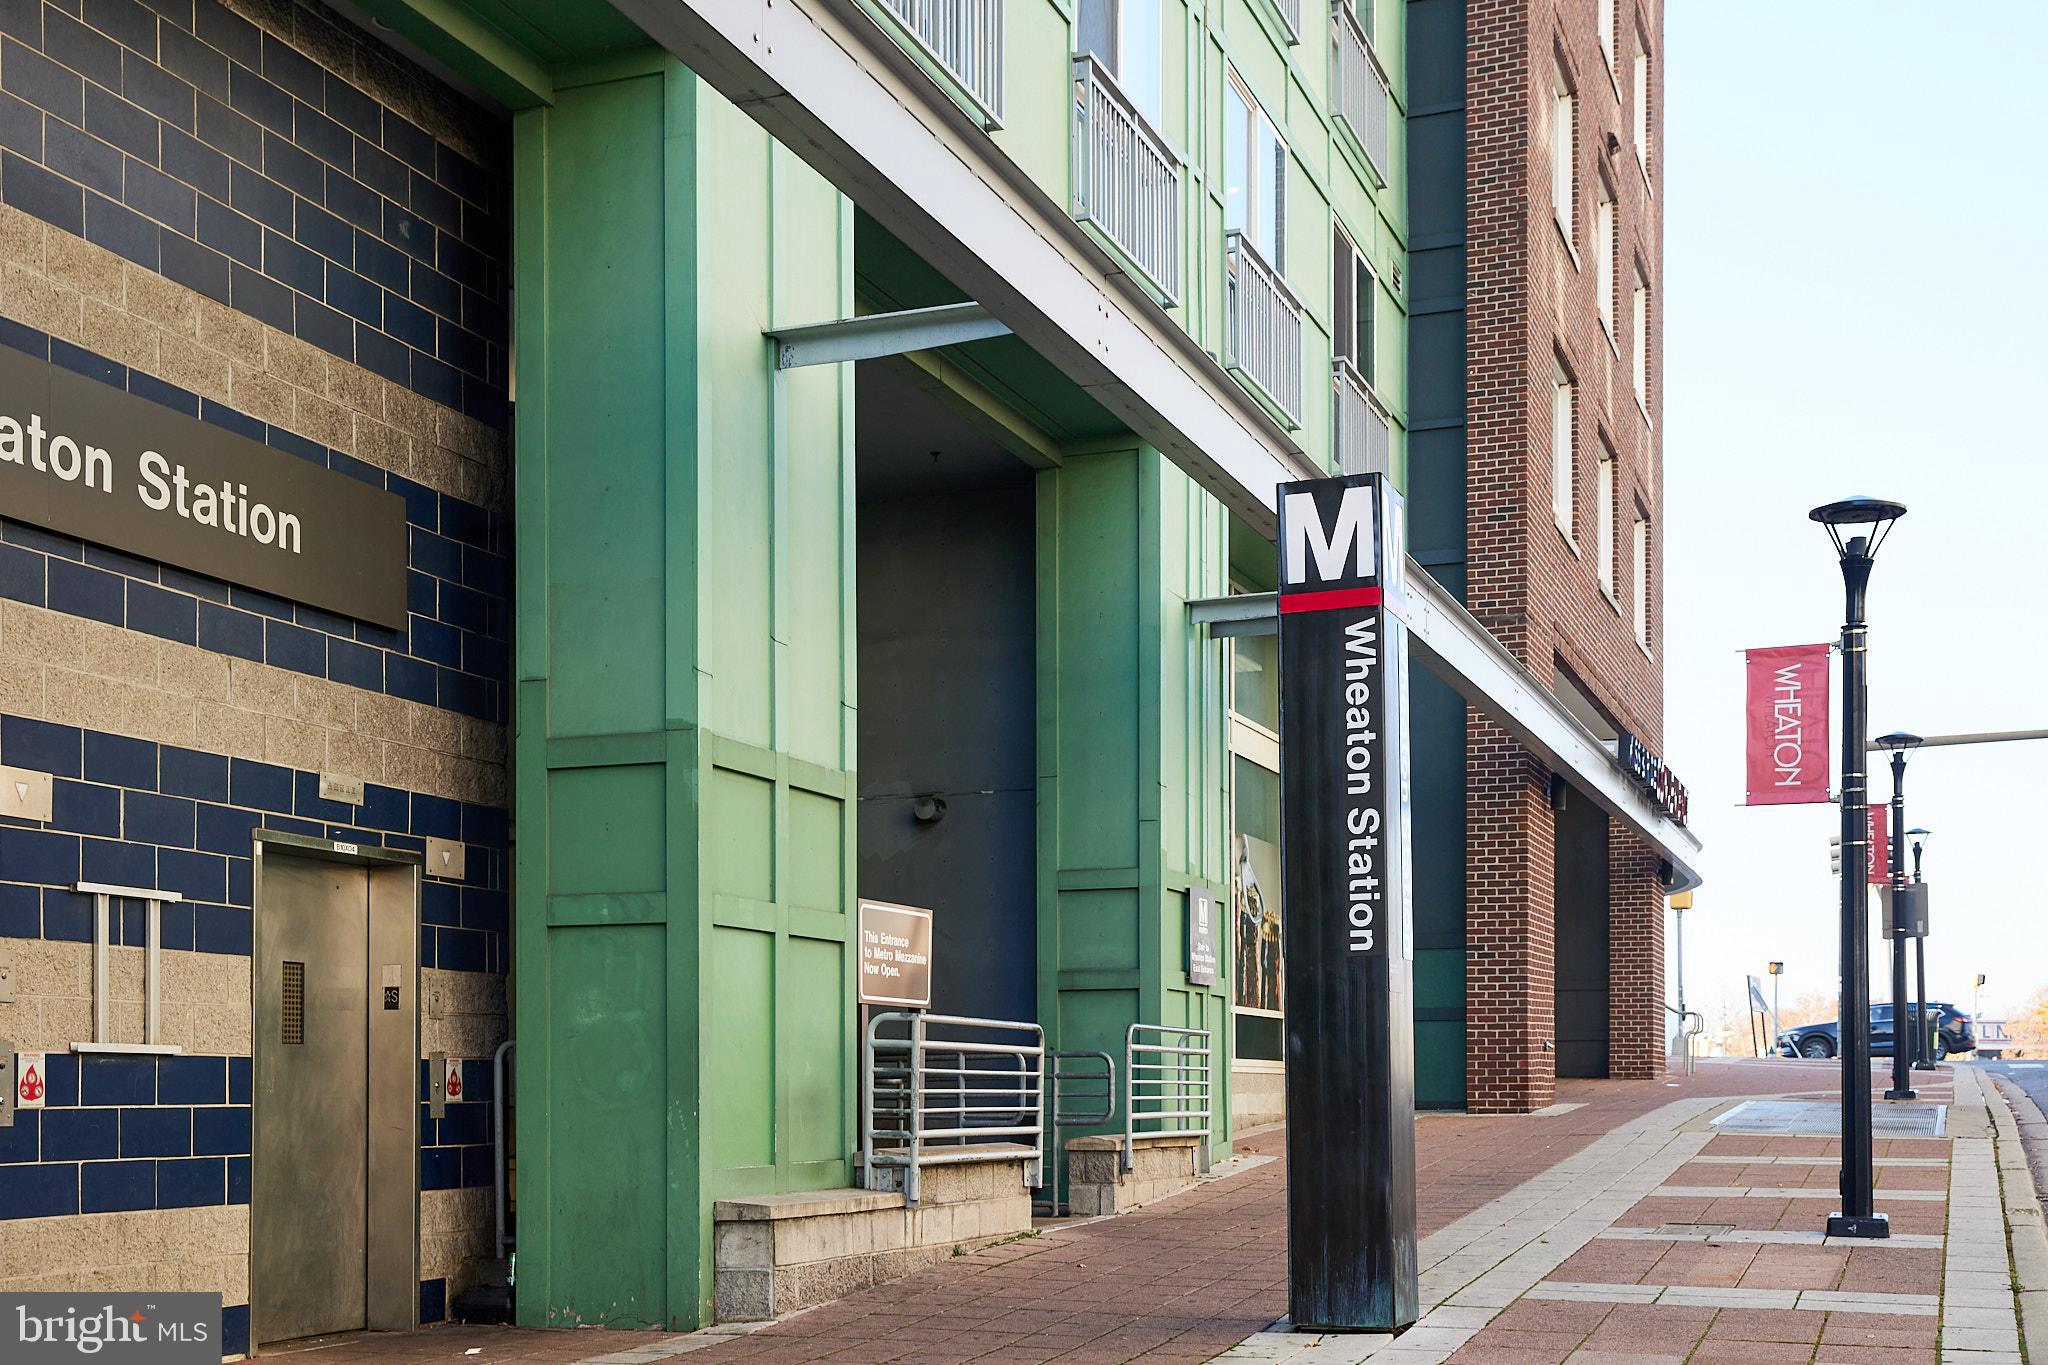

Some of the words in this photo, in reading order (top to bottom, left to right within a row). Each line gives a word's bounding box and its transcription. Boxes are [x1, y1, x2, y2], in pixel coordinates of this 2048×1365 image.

[137, 450, 303, 554] Station
[1284, 486, 1375, 585] M
[1343, 616, 1378, 795] Wheaton
[1773, 663, 1802, 786] WHEATON
[1346, 808, 1381, 953] Station
[864, 948, 872, 958] to
[874, 950, 893, 961] Metro
[895, 951, 927, 965] Mezzanine
[864, 962, 879, 975] Now
[881, 964, 900, 978] Open.
[865, 931, 878, 944] This
[881, 933, 909, 948] Entrance
